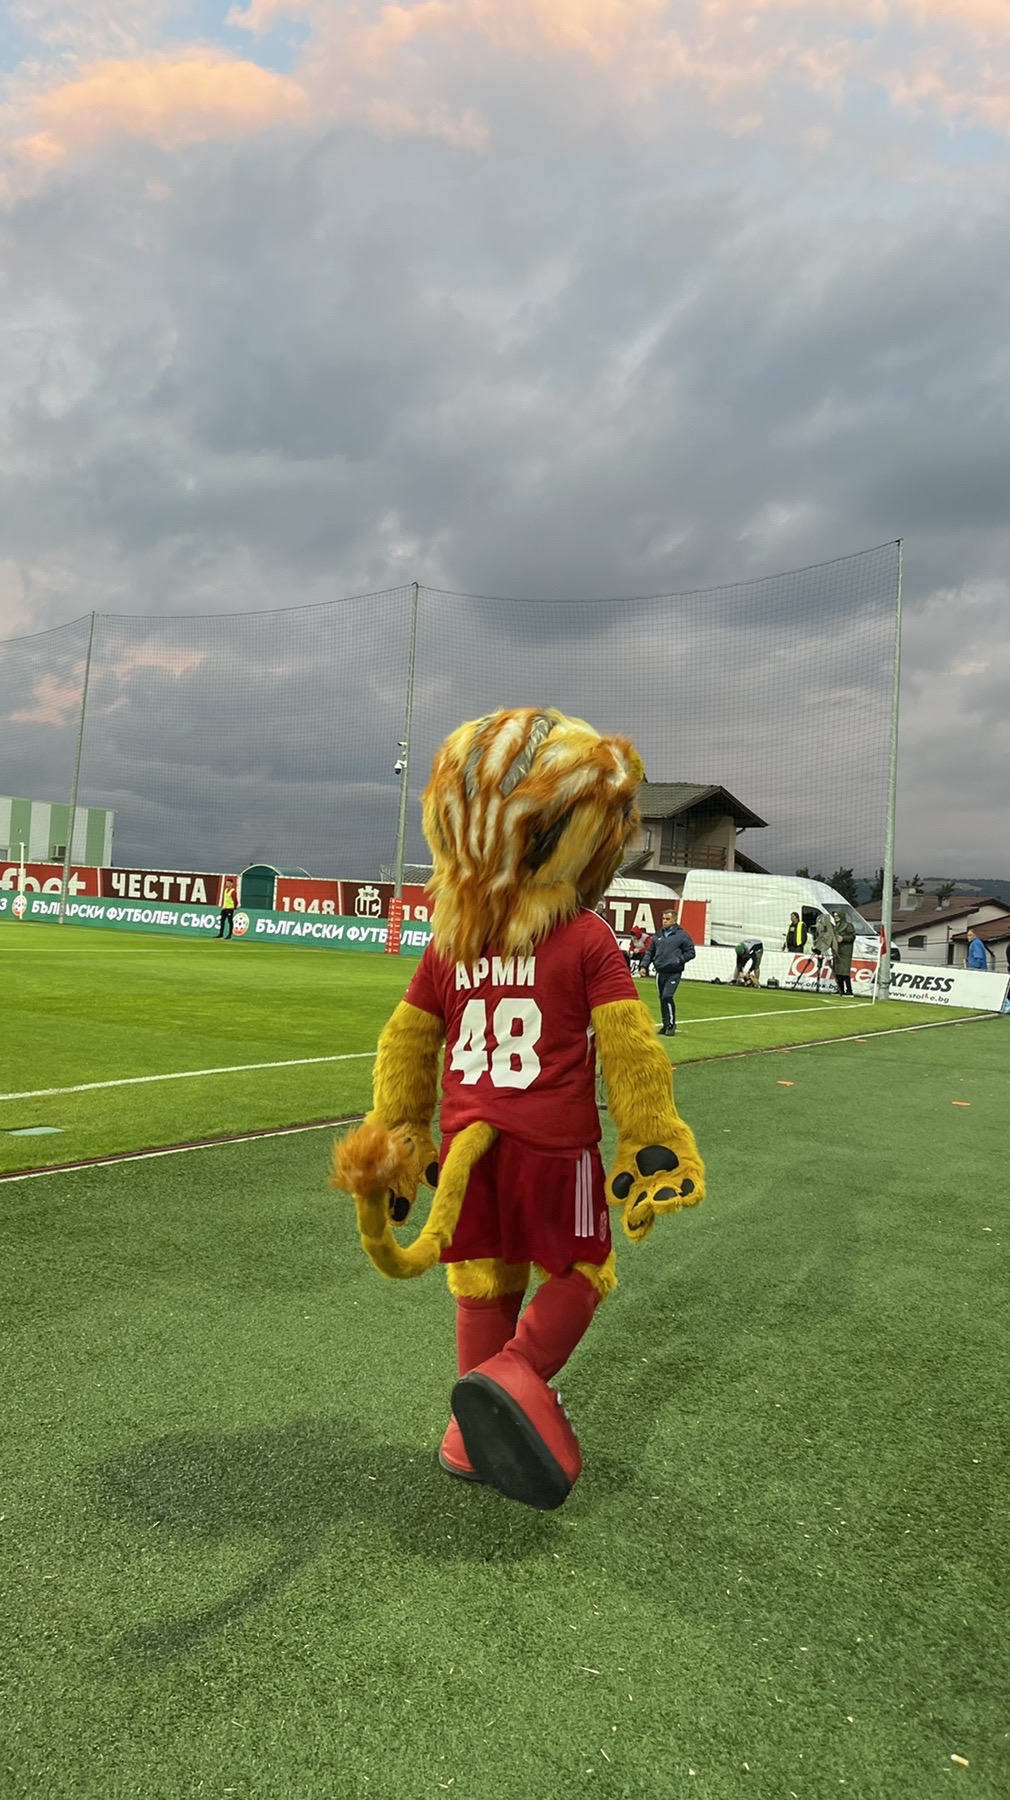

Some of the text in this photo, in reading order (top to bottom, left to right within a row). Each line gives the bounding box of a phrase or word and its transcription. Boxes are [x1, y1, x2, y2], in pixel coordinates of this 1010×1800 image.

[111, 872, 207, 903] ЧЕСТТА
[106, 907, 178, 926] ФУТБОЛЕН
[282, 897, 336, 915] 1948
[255, 918, 344, 940] БЪЛГАРСКИ
[455, 956, 536, 990] АРМИ
[450, 998, 542, 1090] 48
